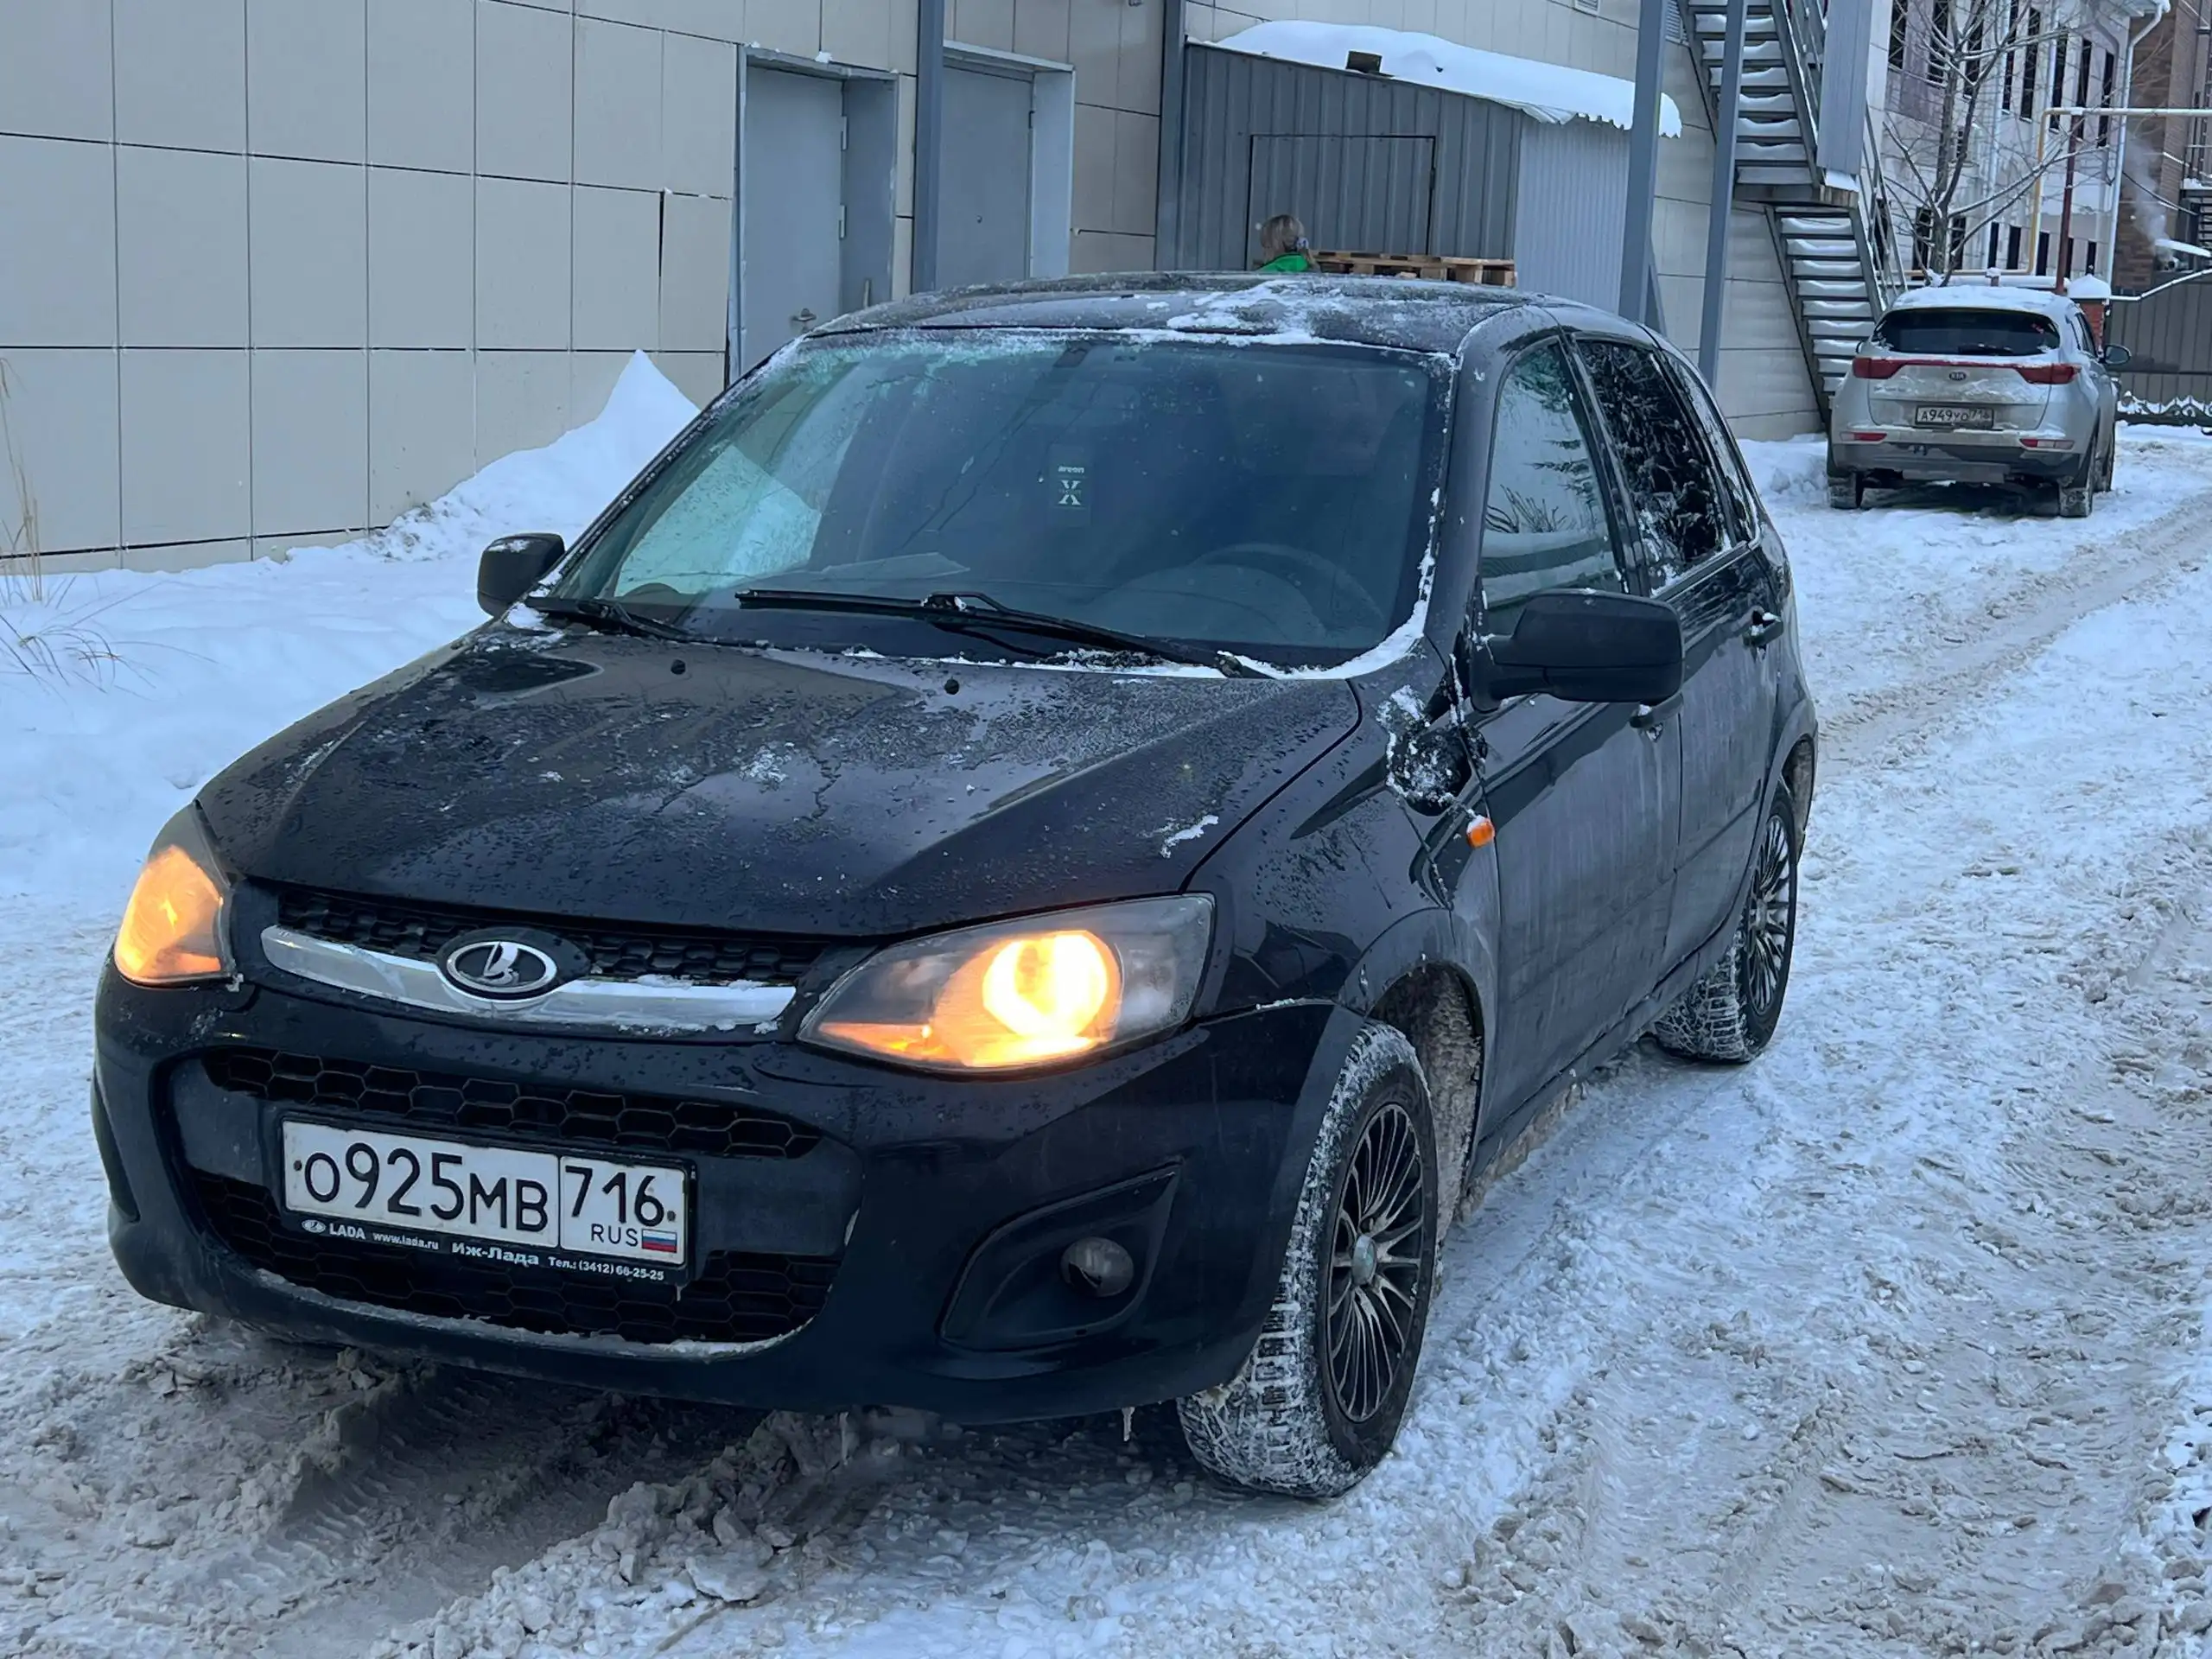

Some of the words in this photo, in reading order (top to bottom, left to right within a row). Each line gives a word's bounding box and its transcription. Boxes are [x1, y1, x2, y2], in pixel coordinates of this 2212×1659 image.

[565, 1166, 664, 1227] 716
[329, 1223, 366, 1240] LADA
[372, 1232, 439, 1249] www.lada.ru
[451, 1242, 539, 1267] Иж-Лада
[578, 1260, 614, 1275] (3412)
[591, 1224, 639, 1248] RUS
